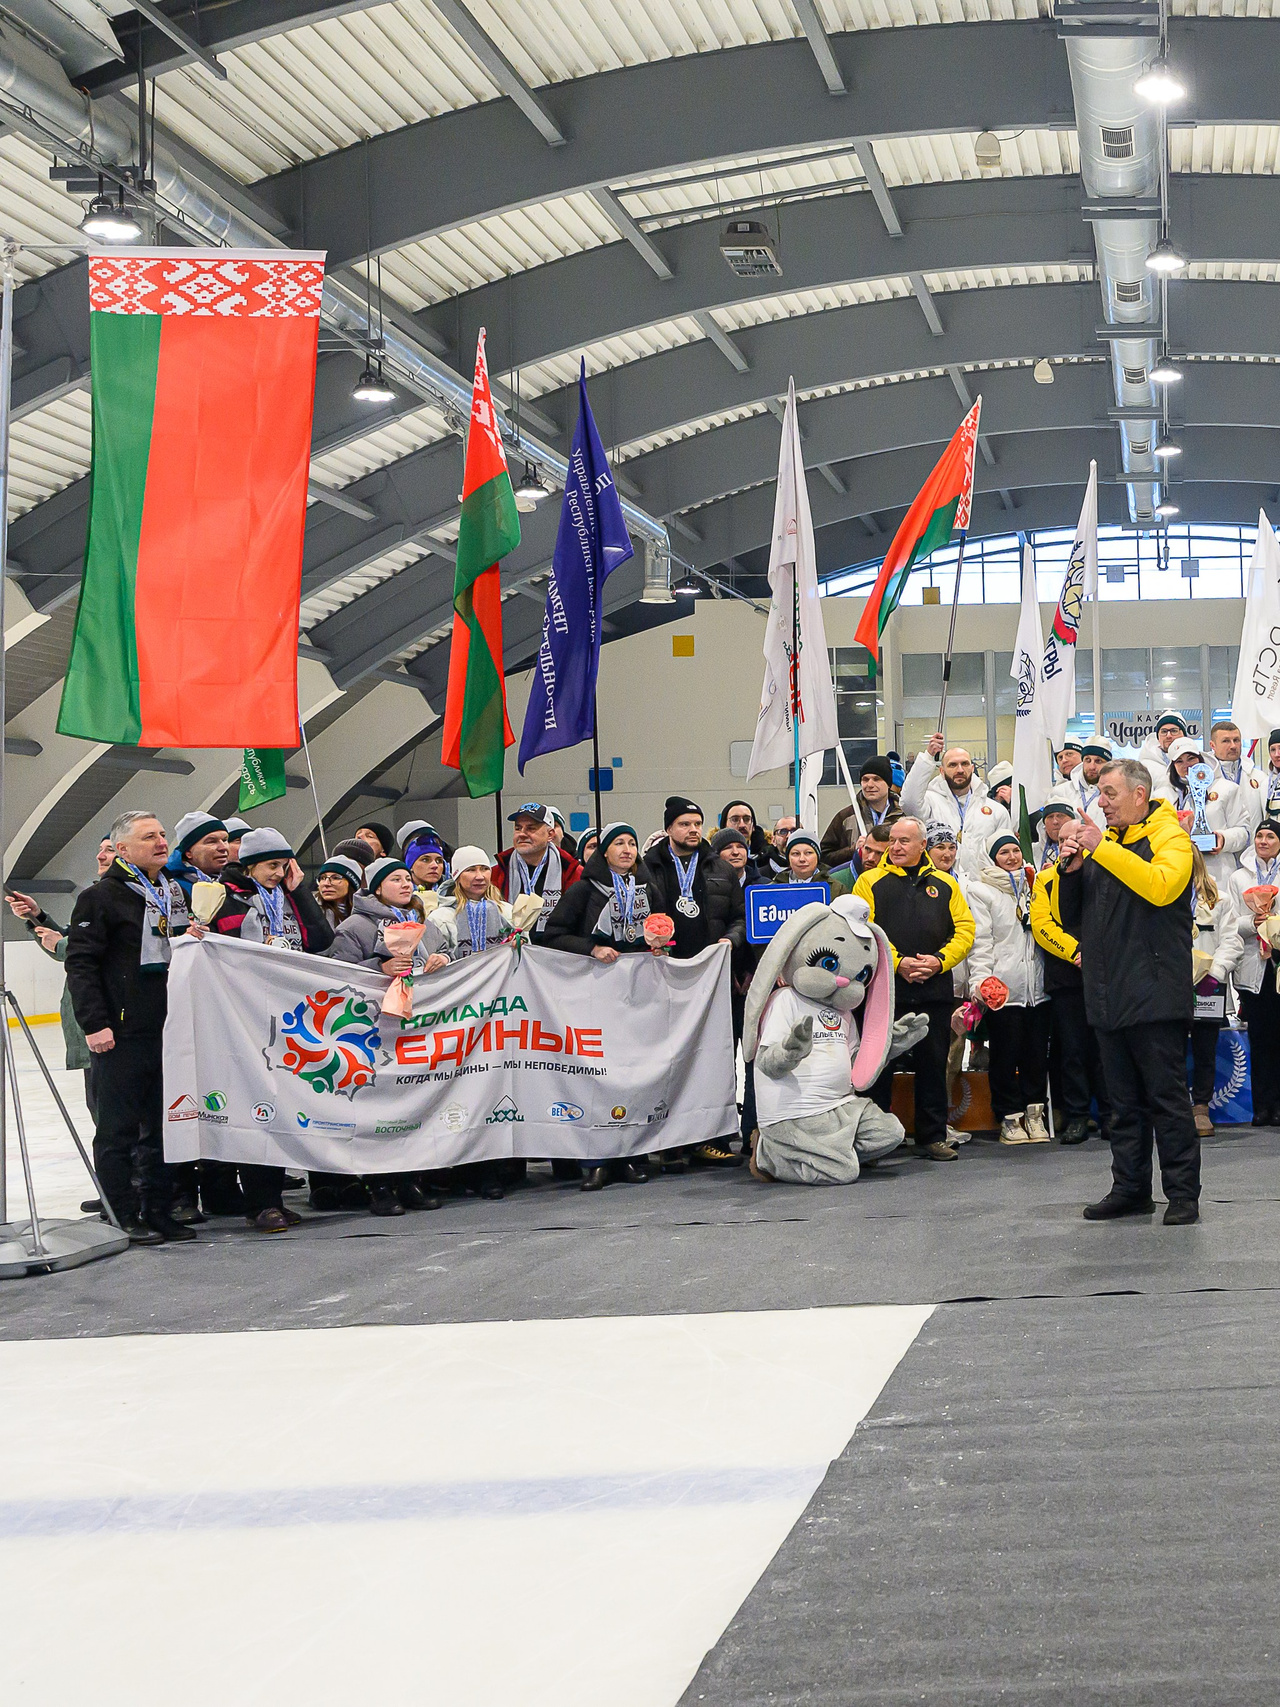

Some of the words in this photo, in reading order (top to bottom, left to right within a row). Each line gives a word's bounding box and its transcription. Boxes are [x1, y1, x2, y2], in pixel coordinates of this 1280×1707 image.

[566, 489, 593, 573] Республики
[547, 566, 569, 635] ТАМЕНТ
[1137, 714, 1160, 722] КАФ
[1040, 928, 1066, 952] BELARUS
[400, 995, 529, 1031] КОМАНДА
[394, 1019, 604, 1071] ЕДИНЫЕ
[395, 1074, 431, 1085] КОГДА
[434, 1070, 453, 1081] МЫ
[503, 1060, 521, 1070] МЫ
[525, 1061, 608, 1076] НЕПОБЕДИМЫ!
